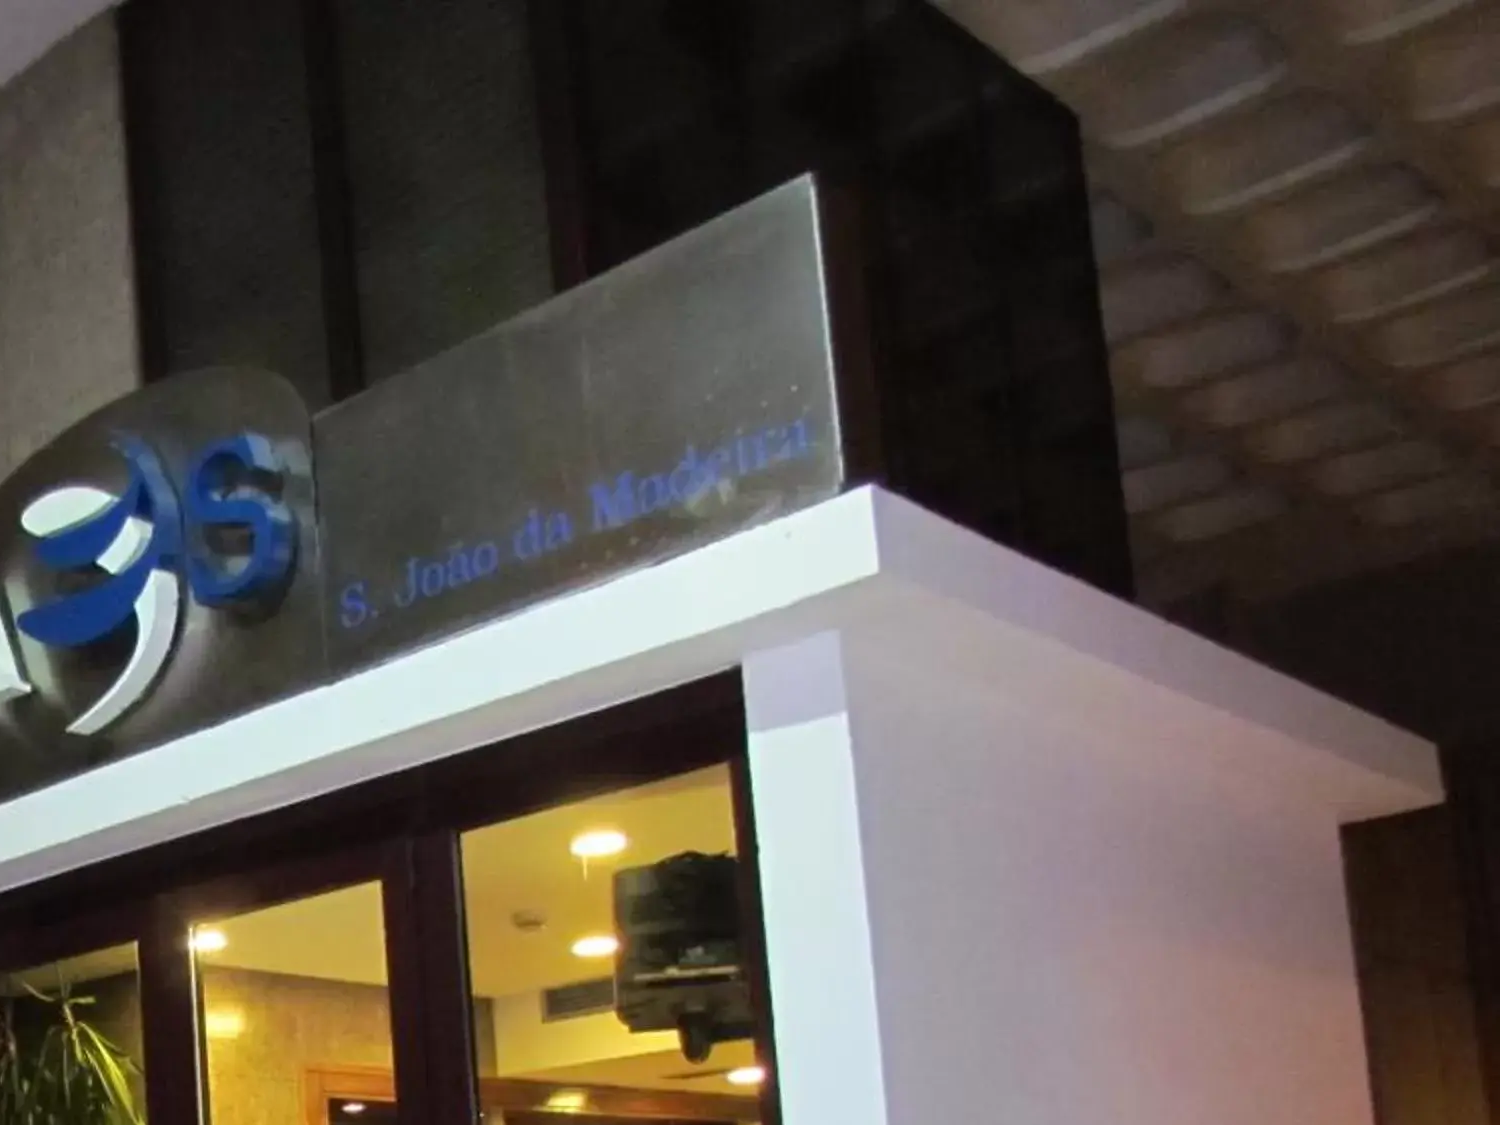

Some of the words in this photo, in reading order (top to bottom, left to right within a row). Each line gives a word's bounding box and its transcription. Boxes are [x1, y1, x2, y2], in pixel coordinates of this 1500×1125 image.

[338, 579, 381, 630] S.
[392, 536, 500, 609] João
[511, 504, 577, 562] da
[587, 417, 812, 533] Madeira
